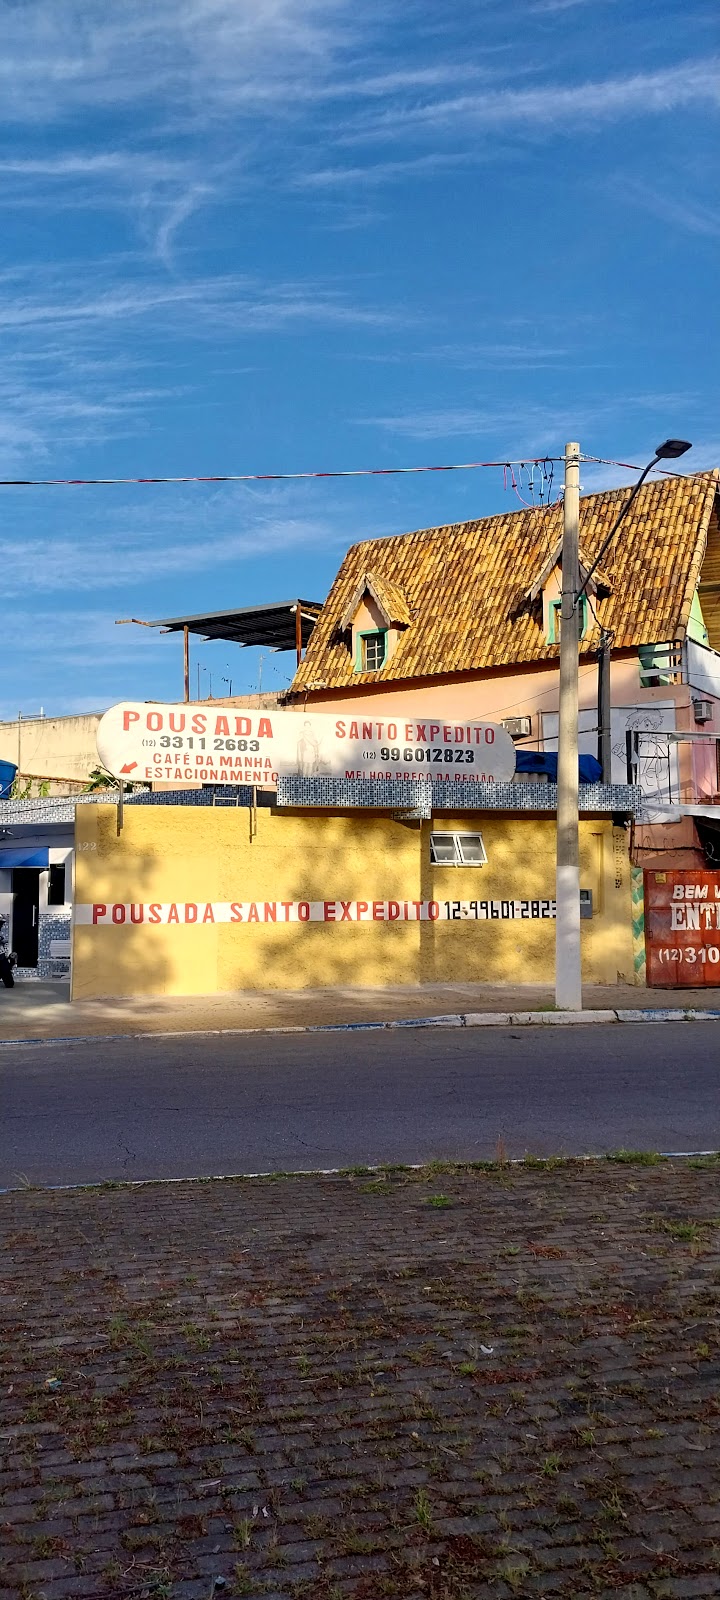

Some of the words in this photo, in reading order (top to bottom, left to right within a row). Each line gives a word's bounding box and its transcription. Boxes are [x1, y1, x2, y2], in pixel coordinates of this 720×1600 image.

[123, 710, 273, 738] POUSADA
[335, 720, 397, 740] SANTO
[405, 724, 495, 744] EXPEDITO
[142, 738, 156, 748] (12)
[160, 735, 206, 750] 3311
[213, 738, 260, 752] 2683
[153, 751, 190, 766] CAFÉ
[195, 755, 214, 766] DA
[362, 750, 376, 760] (12)
[145, 766, 279, 782] ESTACIONAMENTO
[672, 884, 709, 900] BEM
[92, 902, 215, 924] POUSADA
[230, 901, 310, 922] SANTO
